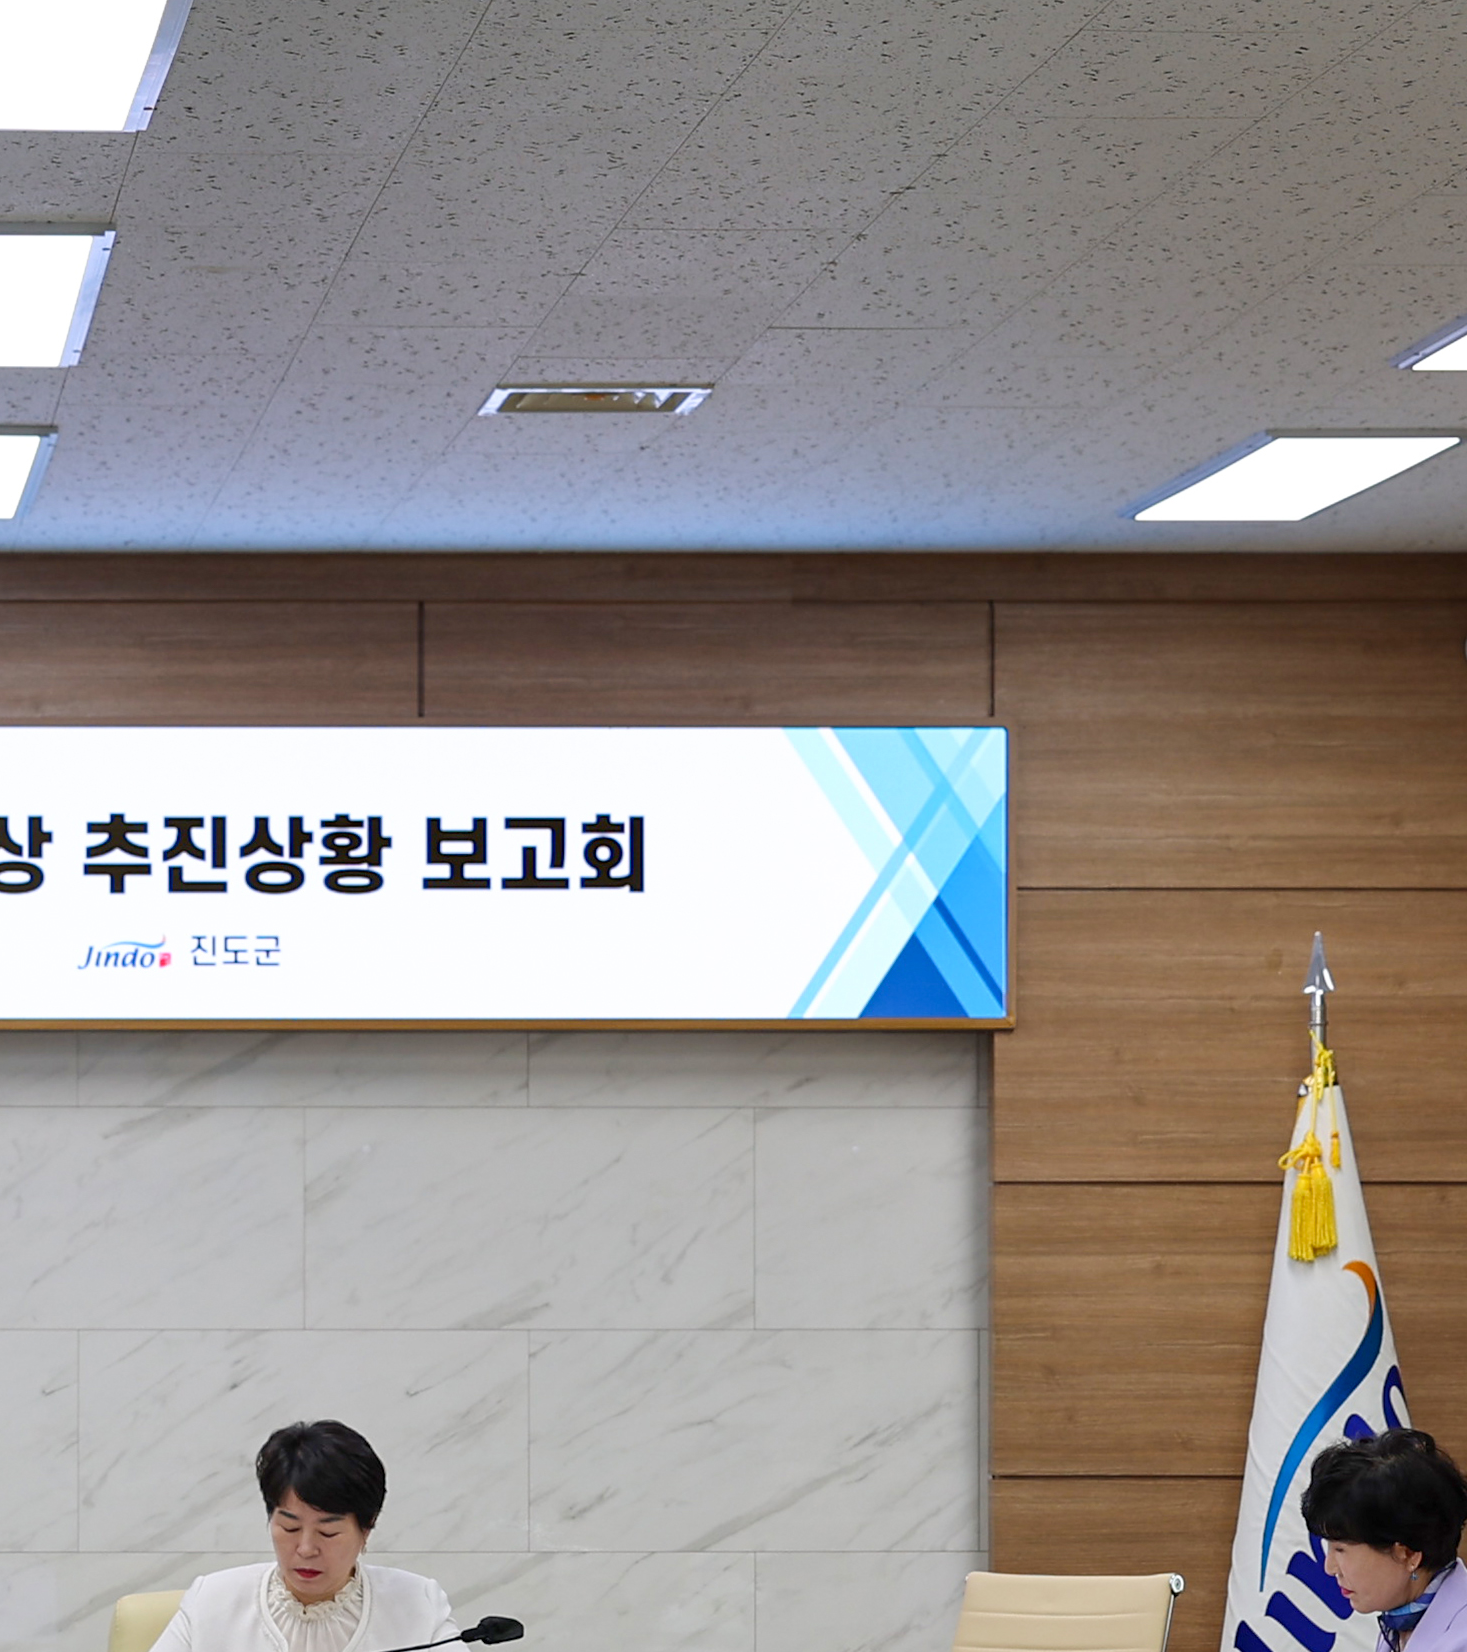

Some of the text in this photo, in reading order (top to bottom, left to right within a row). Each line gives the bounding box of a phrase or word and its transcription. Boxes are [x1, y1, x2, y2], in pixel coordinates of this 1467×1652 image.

[83, 813, 393, 895] 추진상황
[422, 813, 645, 894] 보고회
[77, 945, 156, 970] Jindo
[191, 935, 280, 967] 진도군
